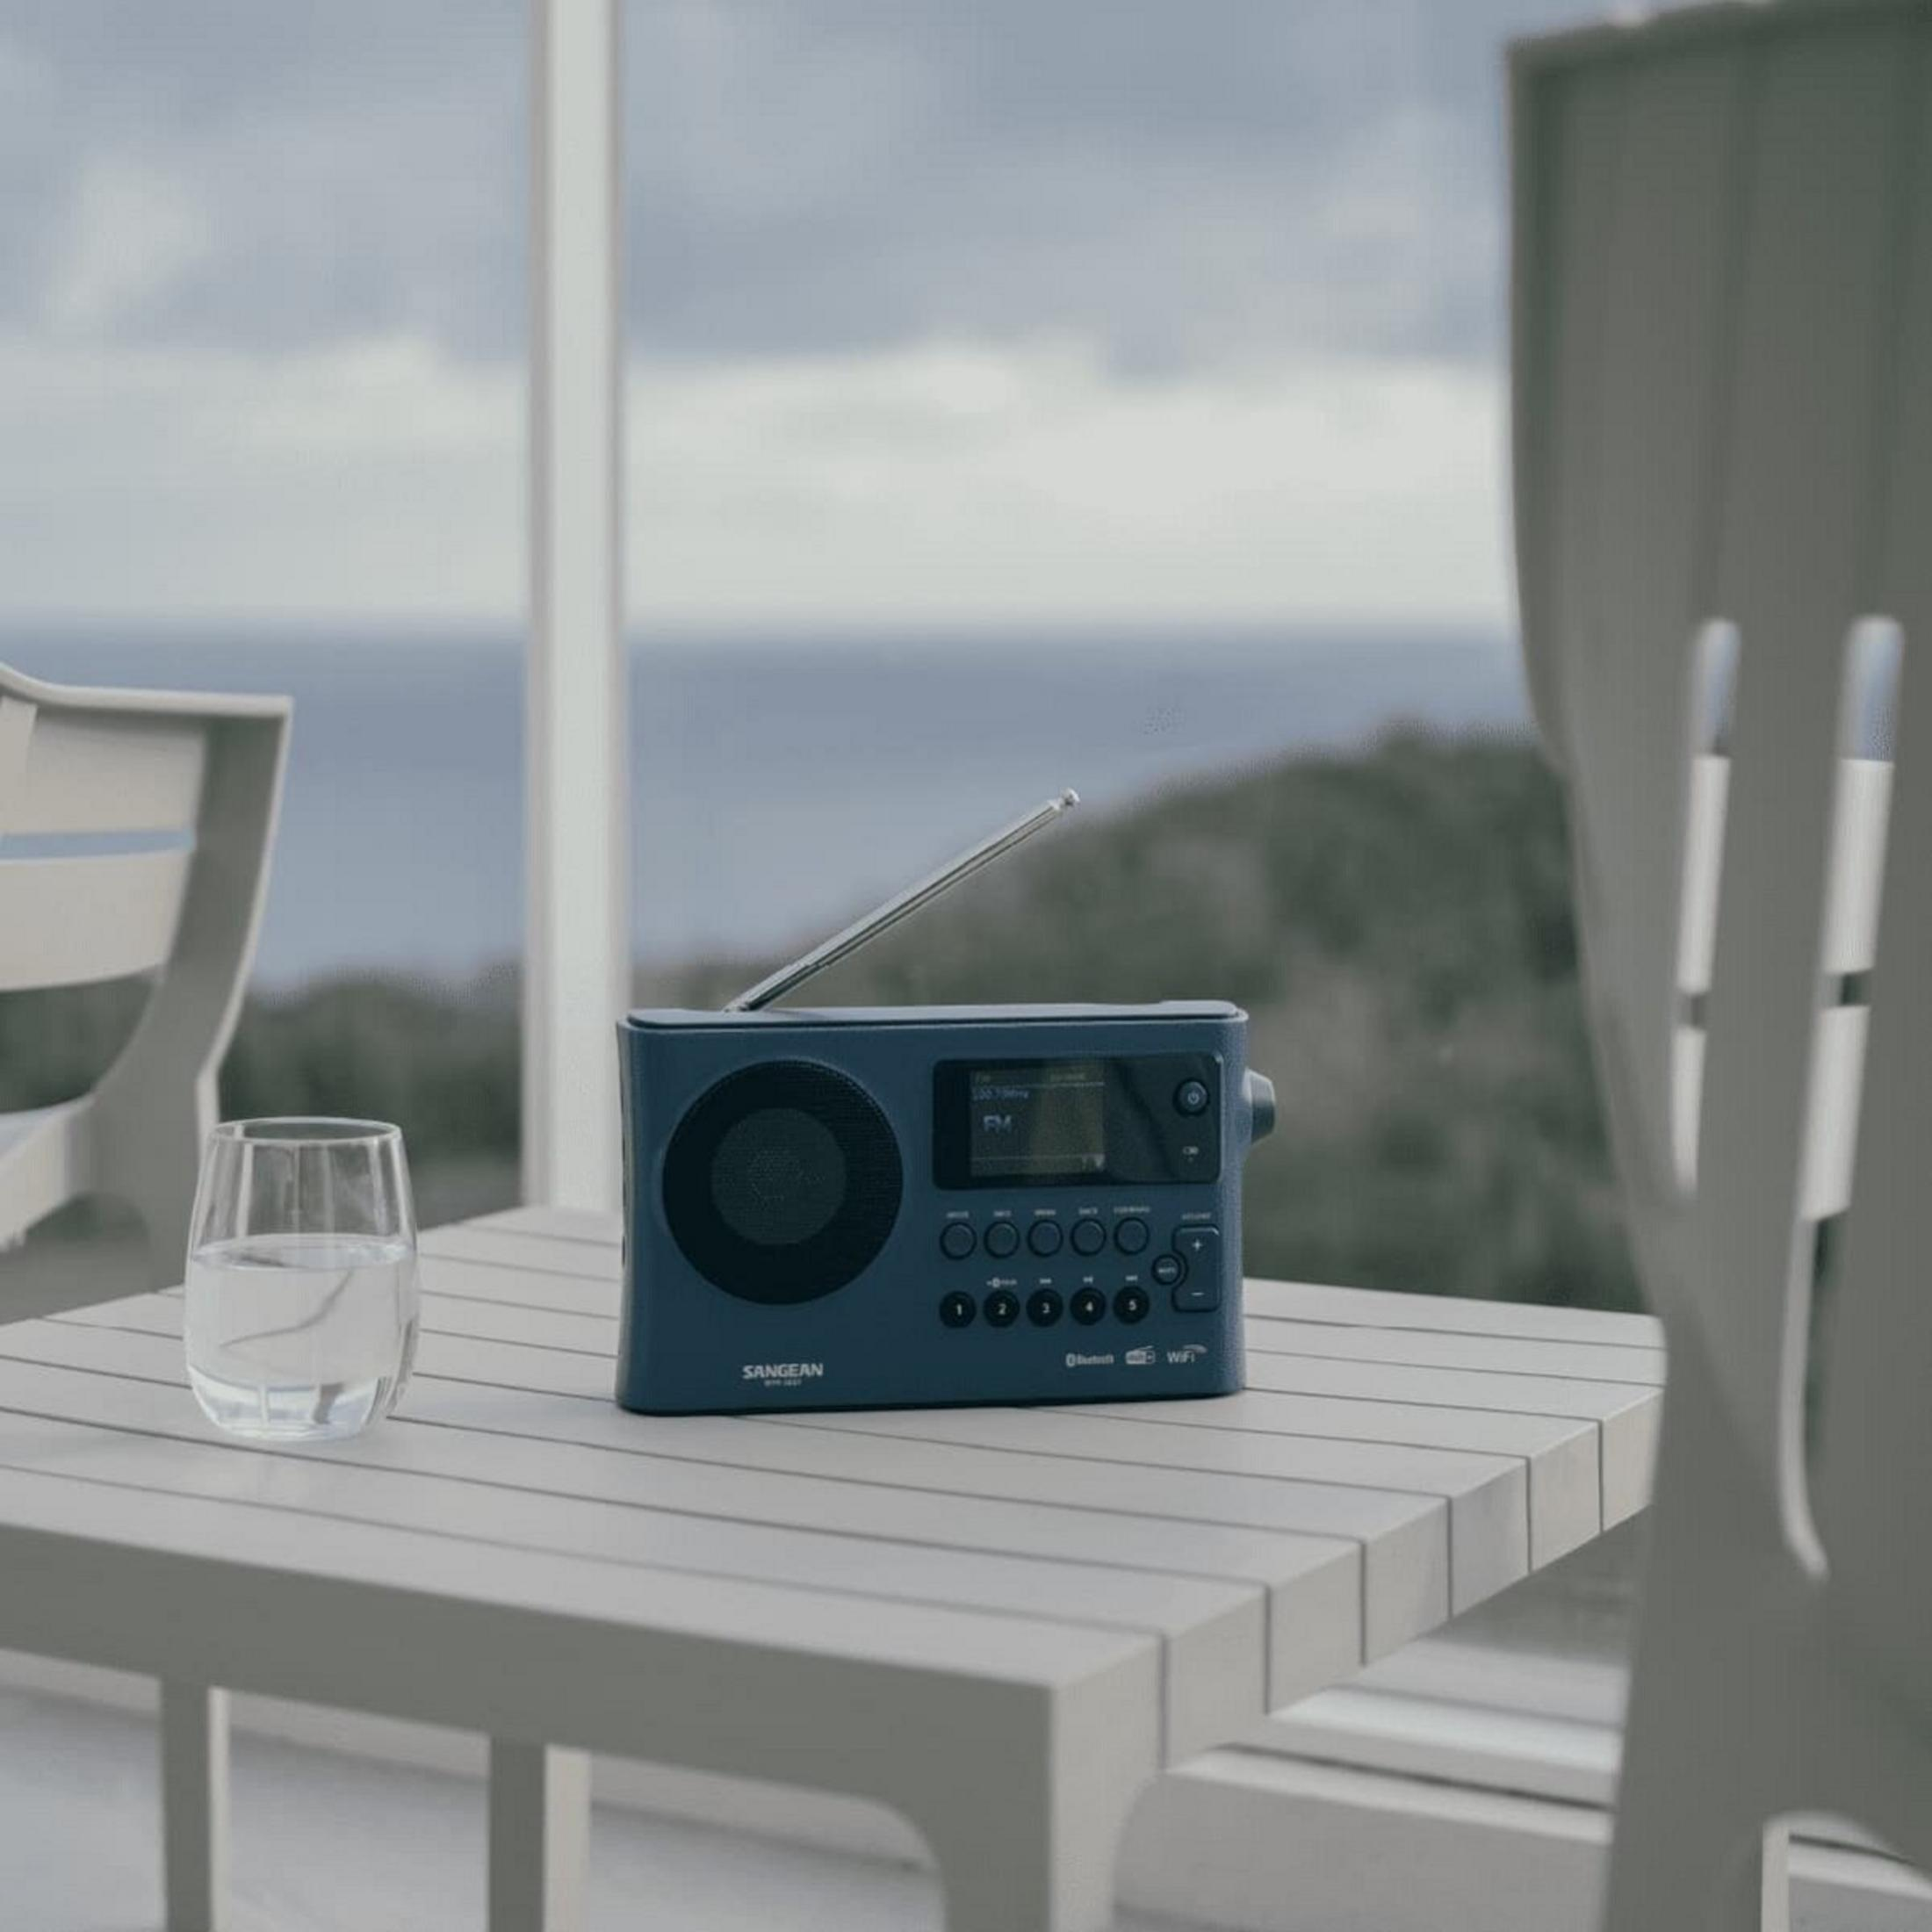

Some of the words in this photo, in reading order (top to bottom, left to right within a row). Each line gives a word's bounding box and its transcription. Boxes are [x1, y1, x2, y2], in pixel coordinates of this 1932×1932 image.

[955, 1303, 963, 1316] 1
[998, 1303, 1006, 1316] 2
[1042, 1302, 1050, 1314] 3
[1085, 1301, 1094, 1312] 4
[1128, 1299, 1137, 1311] 5
[1166, 1351, 1196, 1363] WiFi
[742, 1362, 825, 1380] SANGEAN
